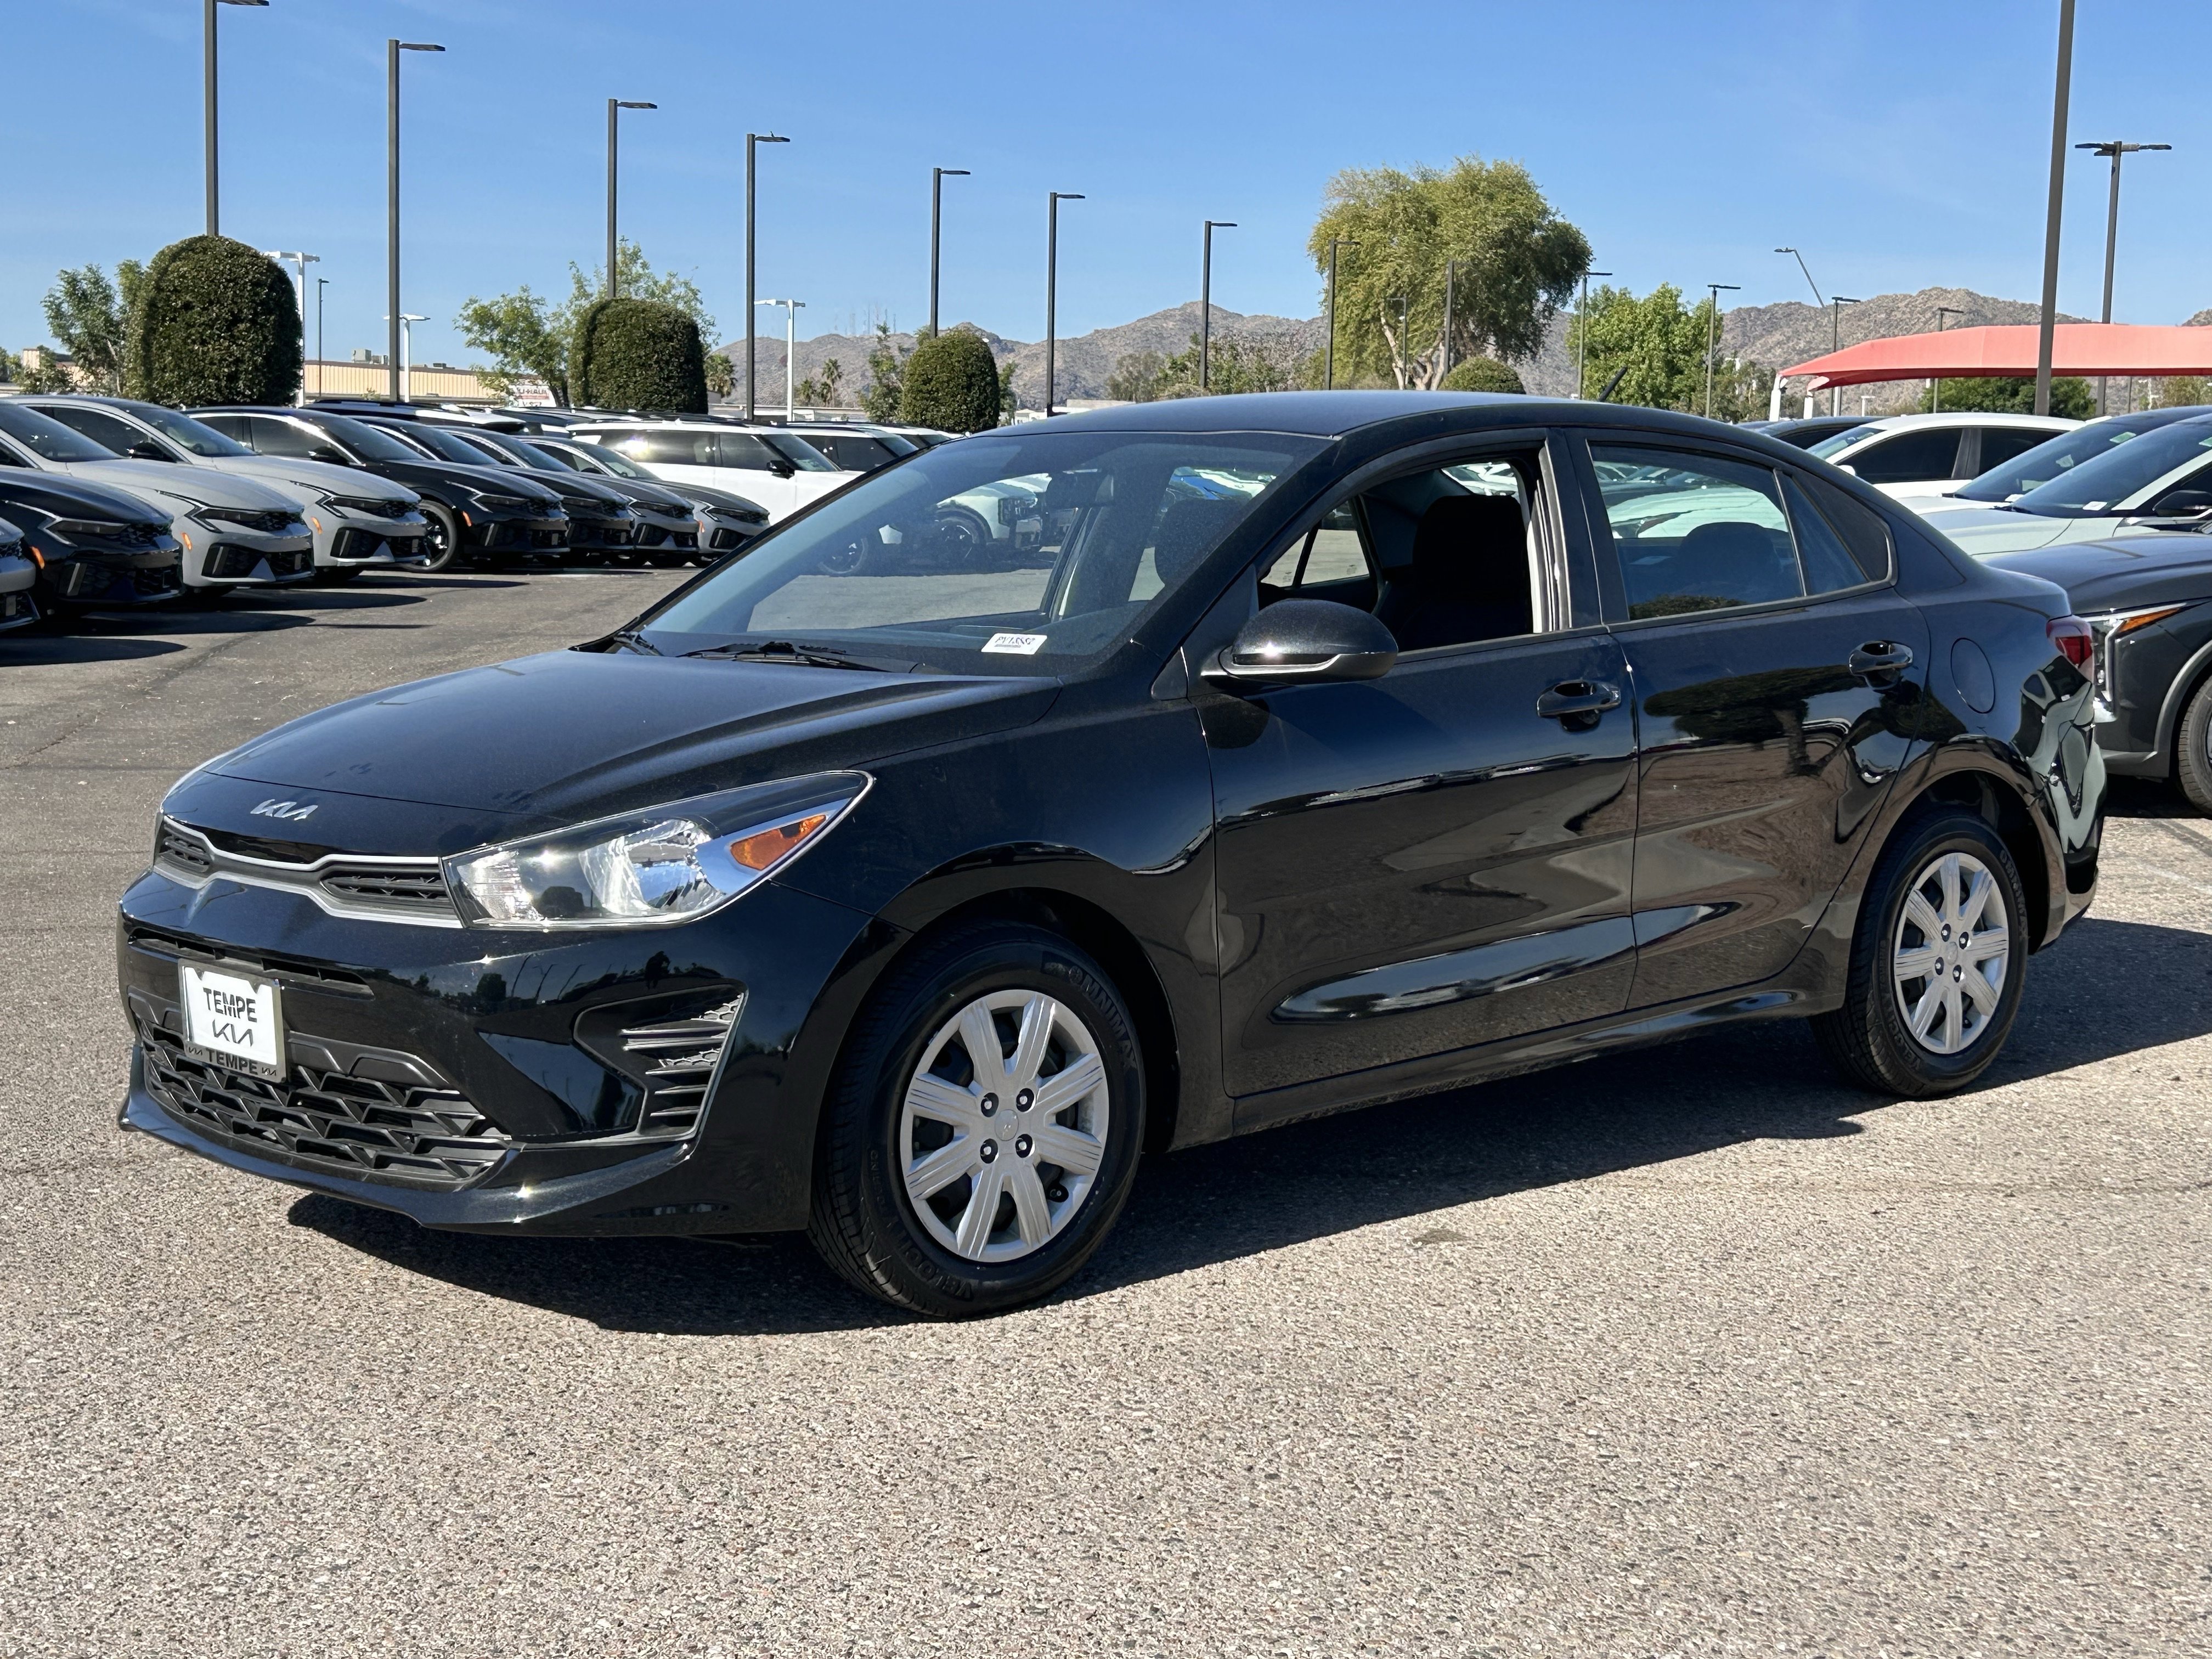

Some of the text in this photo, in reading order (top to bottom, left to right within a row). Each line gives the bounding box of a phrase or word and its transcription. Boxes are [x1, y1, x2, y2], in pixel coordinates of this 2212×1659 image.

[250, 799, 318, 821] KIA
[203, 987, 257, 1023] TEMPE
[212, 1019, 254, 1047] KIA
[205, 1048, 258, 1075] TEMPE
